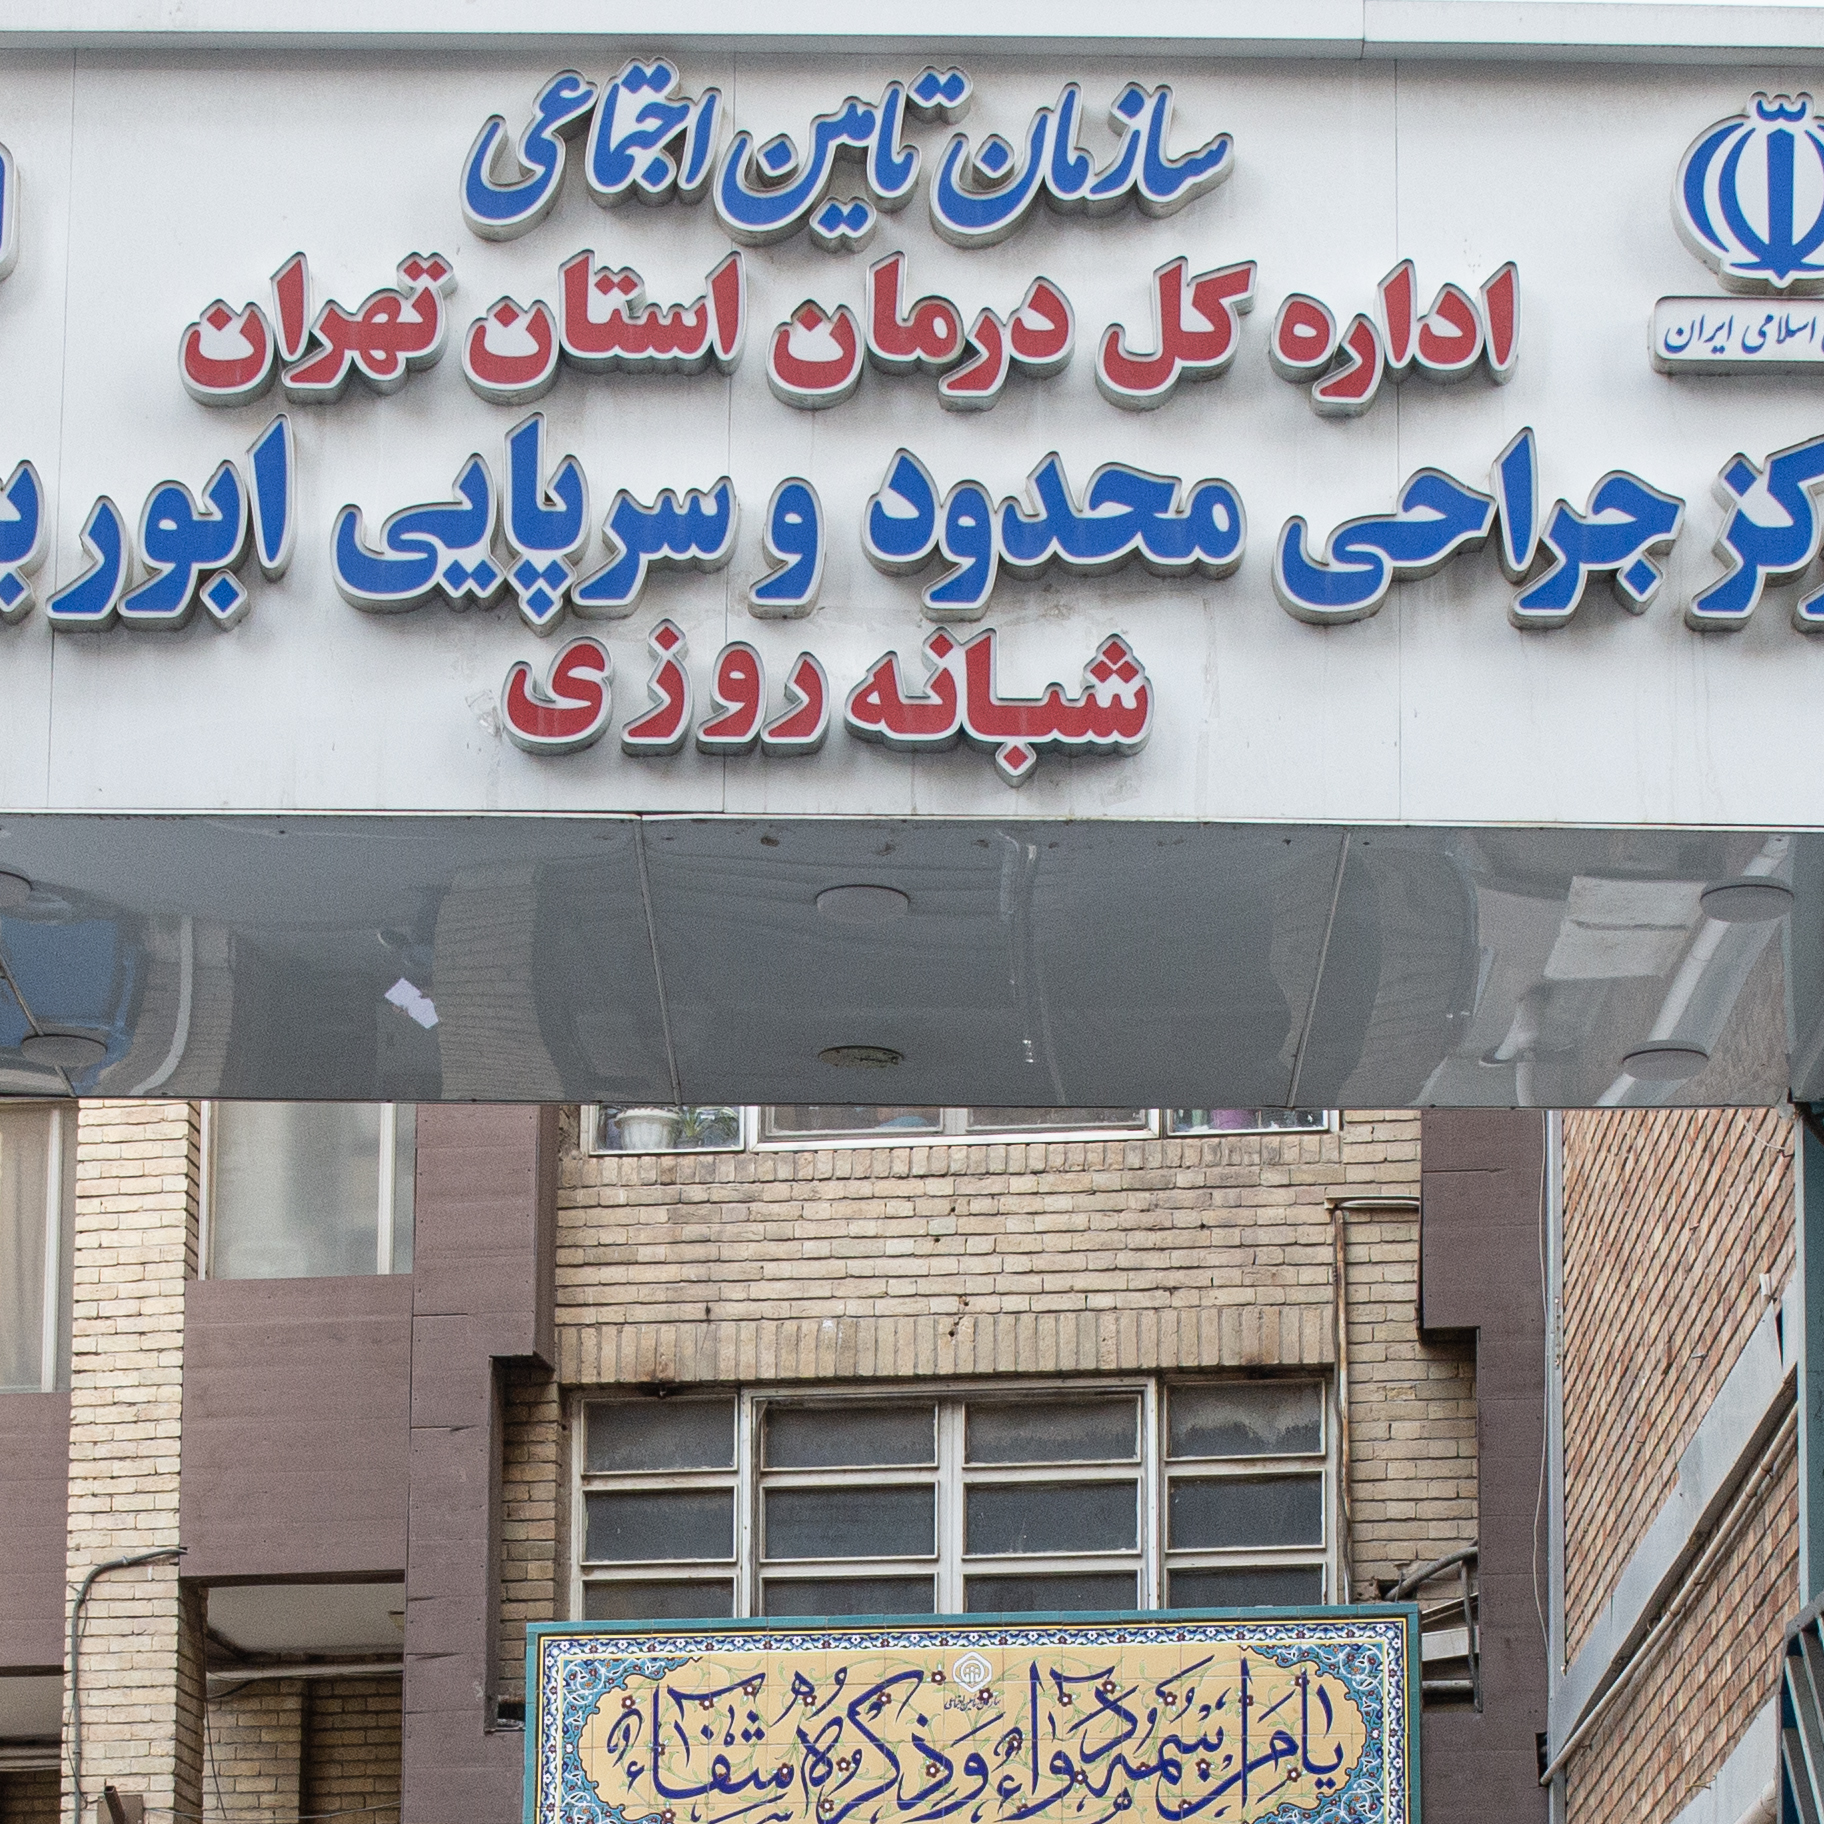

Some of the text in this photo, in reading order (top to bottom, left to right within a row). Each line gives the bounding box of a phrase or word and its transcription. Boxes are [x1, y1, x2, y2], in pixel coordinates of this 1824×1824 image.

[465, 63, 1229, 232] سازمان تامین اجتماعی
[184, 255, 1515, 399] اداره کل درمان استان تهران
[1663, 313, 1735, 354] ایران
[1740, 312, 1817, 354] اسلامی
[335, 418, 731, 618] سرپایی
[754, 482, 819, 600] و
[868, 454, 1242, 603] محدود
[1281, 434, 1681, 610] جراحی
[506, 626, 1149, 772] شبانه روزی
